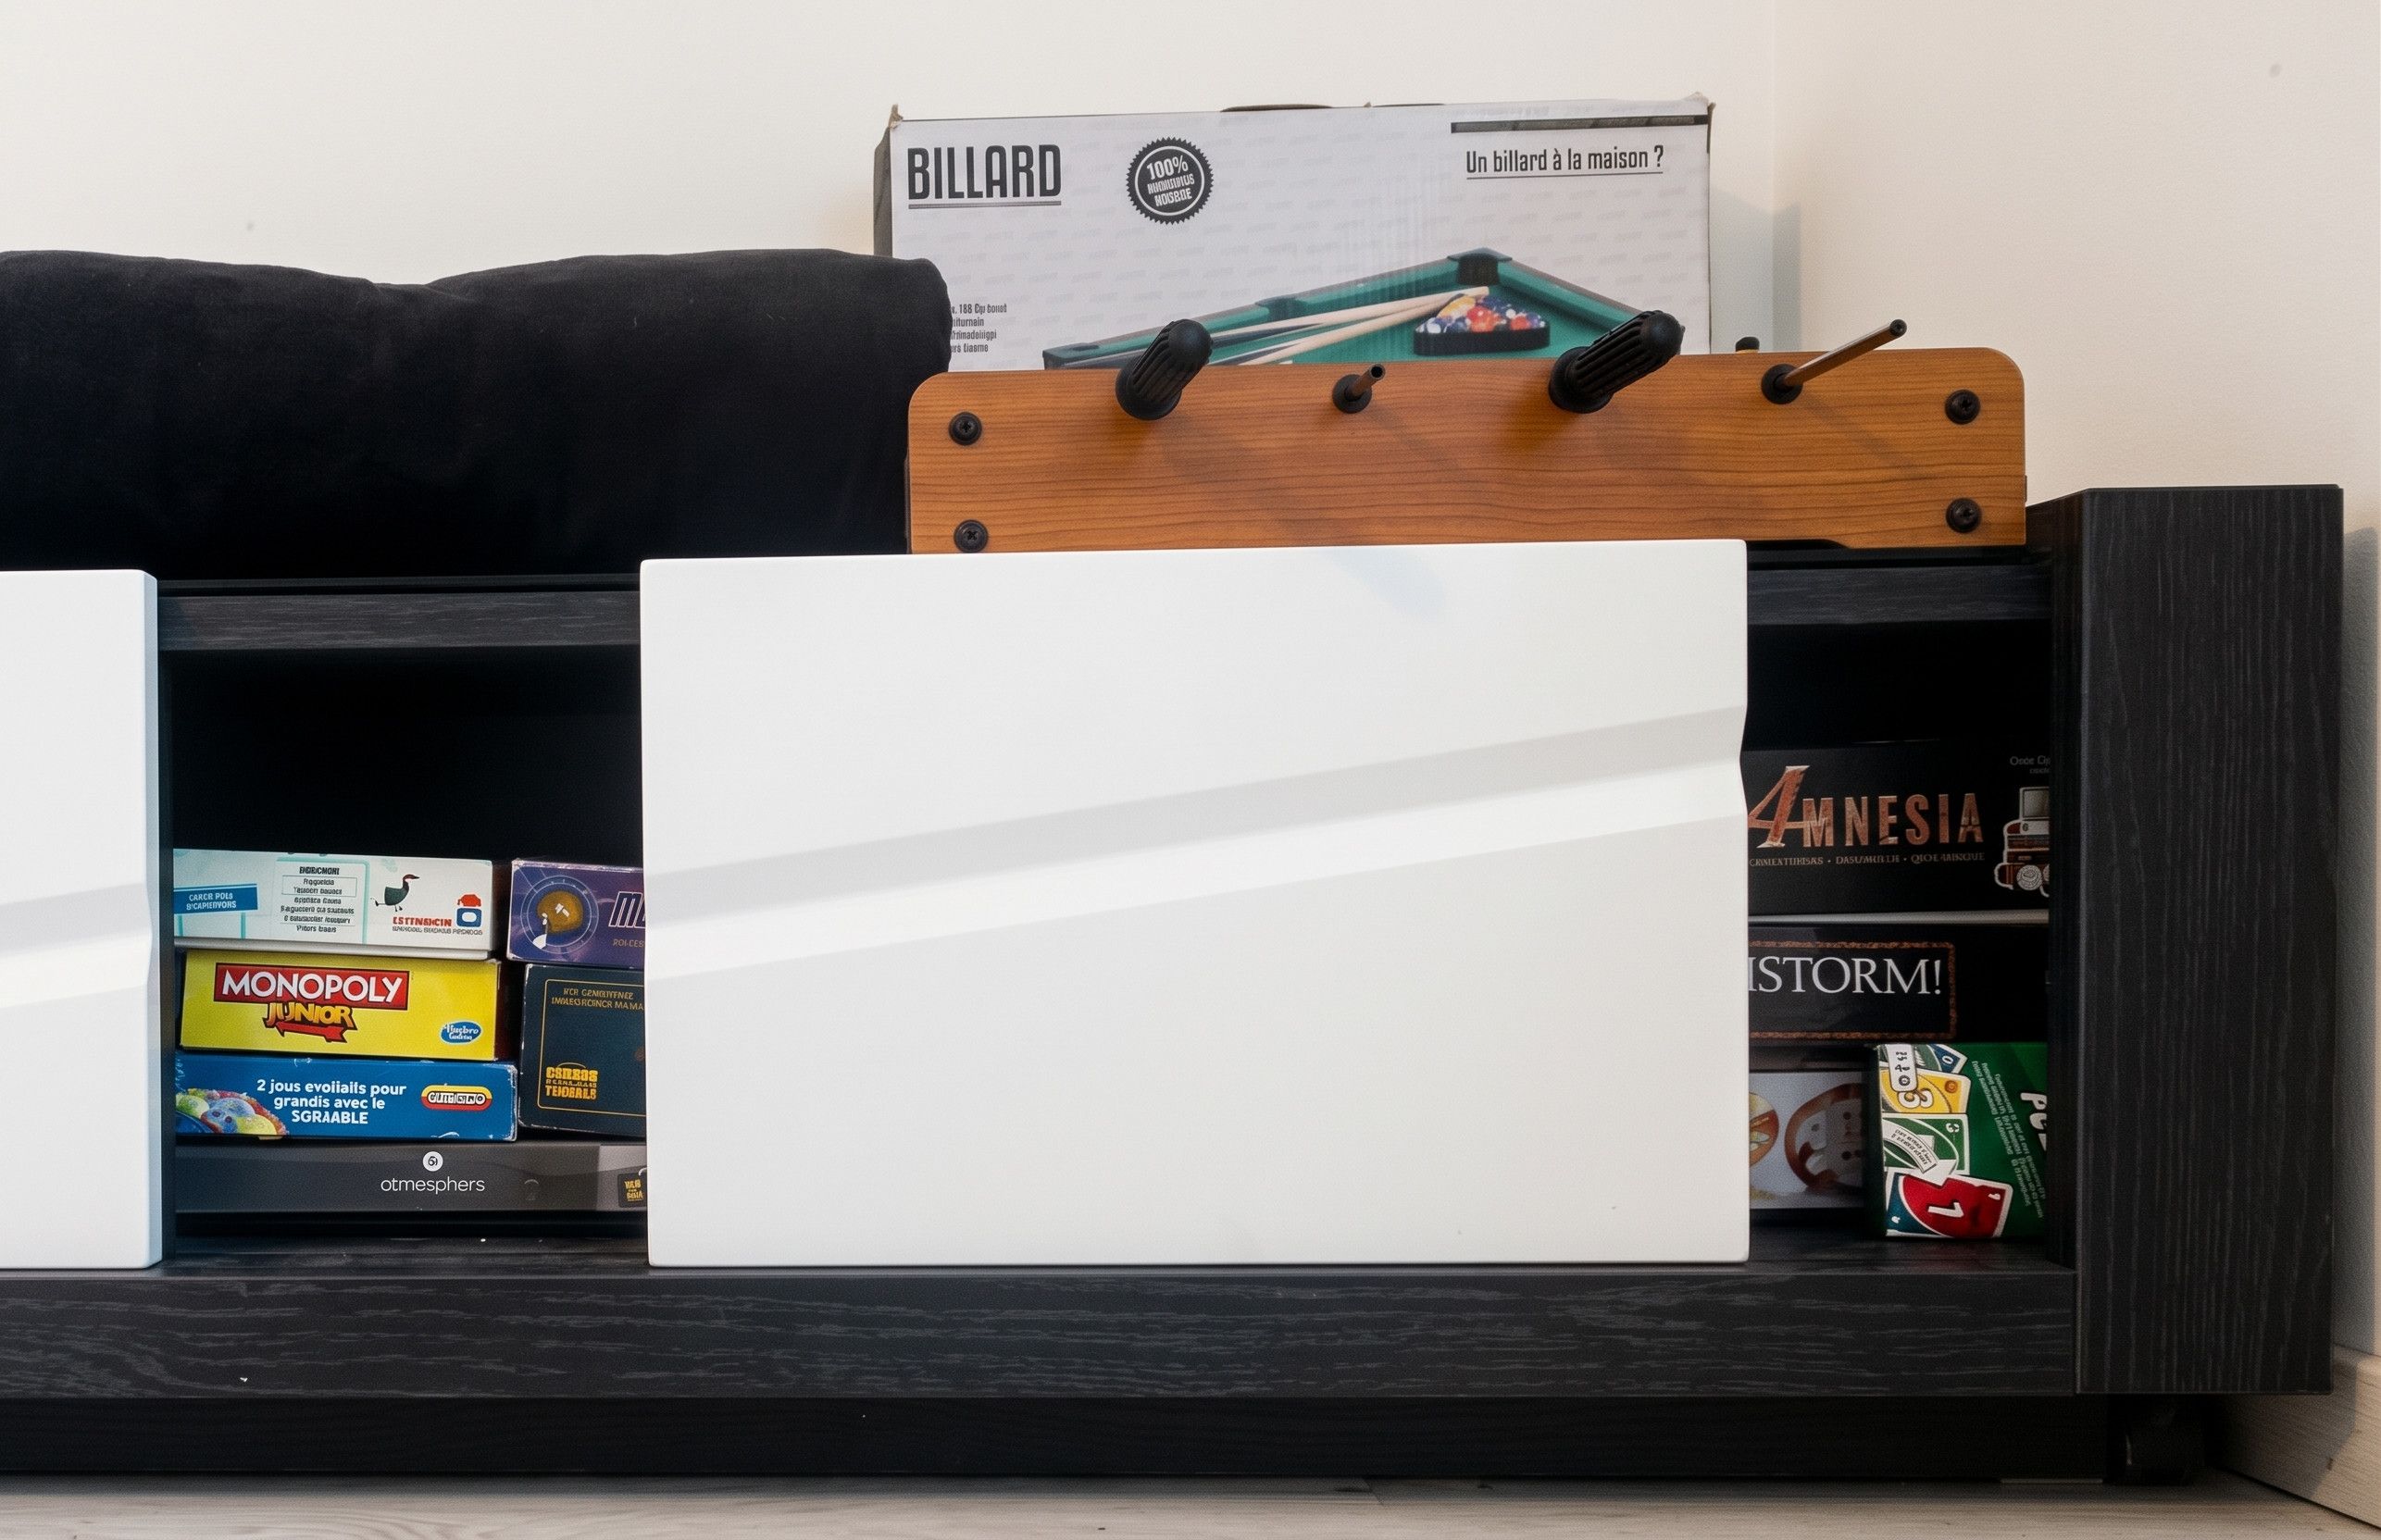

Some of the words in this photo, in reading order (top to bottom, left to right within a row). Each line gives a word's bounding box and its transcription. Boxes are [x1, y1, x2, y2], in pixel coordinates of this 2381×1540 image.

[1147, 155, 1190, 180] 100%
[1466, 150, 1488, 174] Un
[1493, 149, 1548, 172] billard
[1552, 148, 1563, 171] à
[1567, 148, 1582, 170] la
[1588, 146, 1648, 169] maison
[1654, 144, 1664, 168] ?
[908, 144, 1061, 200] BILLARD
[222, 970, 403, 1003] MONOPOLY
[266, 1001, 355, 1028] JUNIOR
[256, 1079, 267, 1091] 2
[268, 1079, 302, 1095] jous
[369, 1085, 407, 1098] pour
[273, 1096, 330, 1110] grandis
[333, 1099, 368, 1110] avec
[371, 1097, 386, 1110] le
[291, 1110, 369, 1124] SGRAABLE
[380, 1175, 485, 1195] otmesphers
